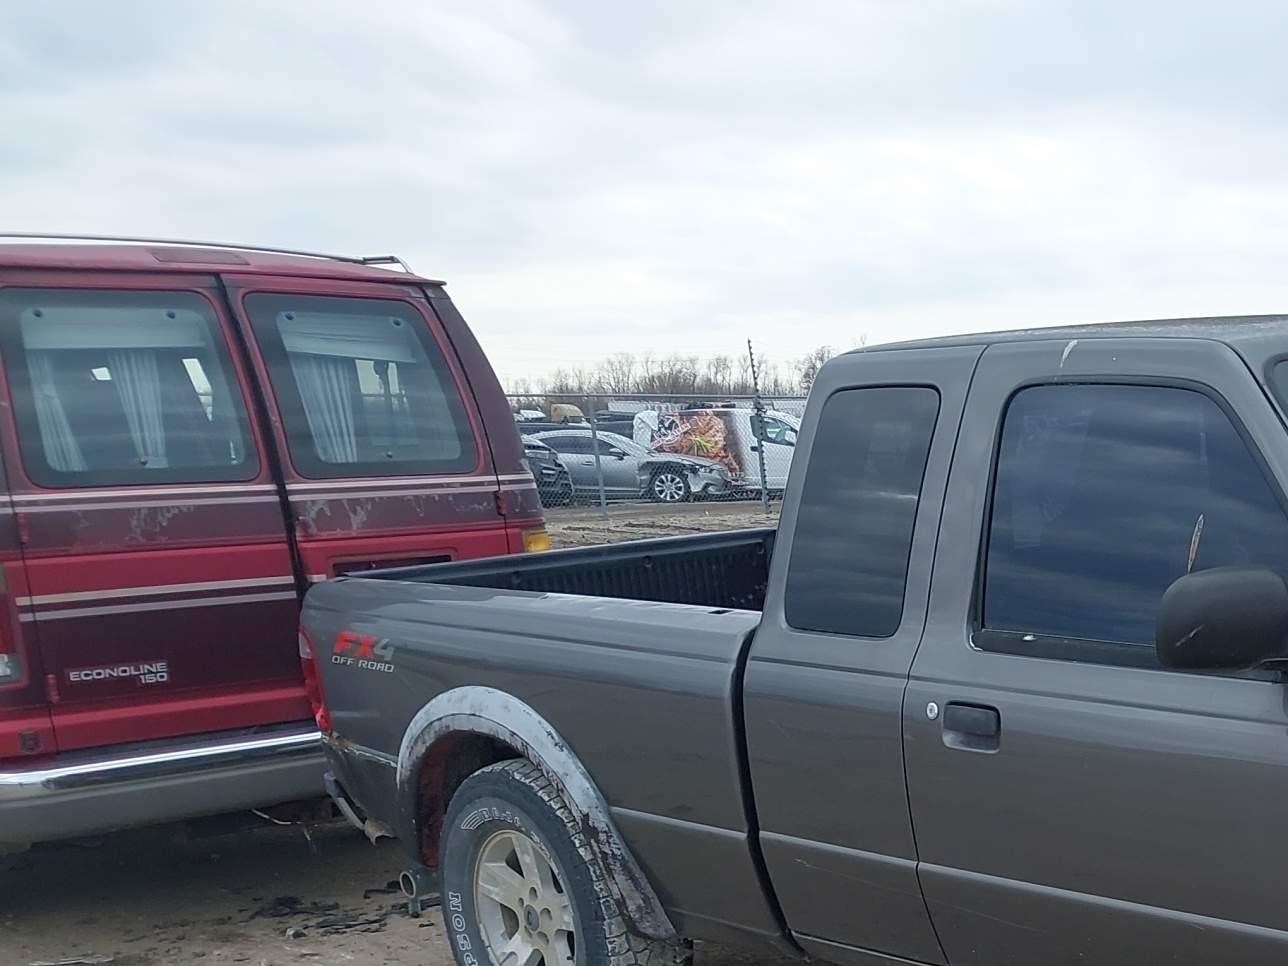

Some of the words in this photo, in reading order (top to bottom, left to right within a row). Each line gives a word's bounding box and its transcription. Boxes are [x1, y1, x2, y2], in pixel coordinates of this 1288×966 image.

[332, 630, 394, 661] FX4
[69, 662, 168, 681] ECONOLINE
[331, 655, 355, 666] OFF
[358, 660, 395, 673] ROAD
[139, 673, 168, 684] 150
